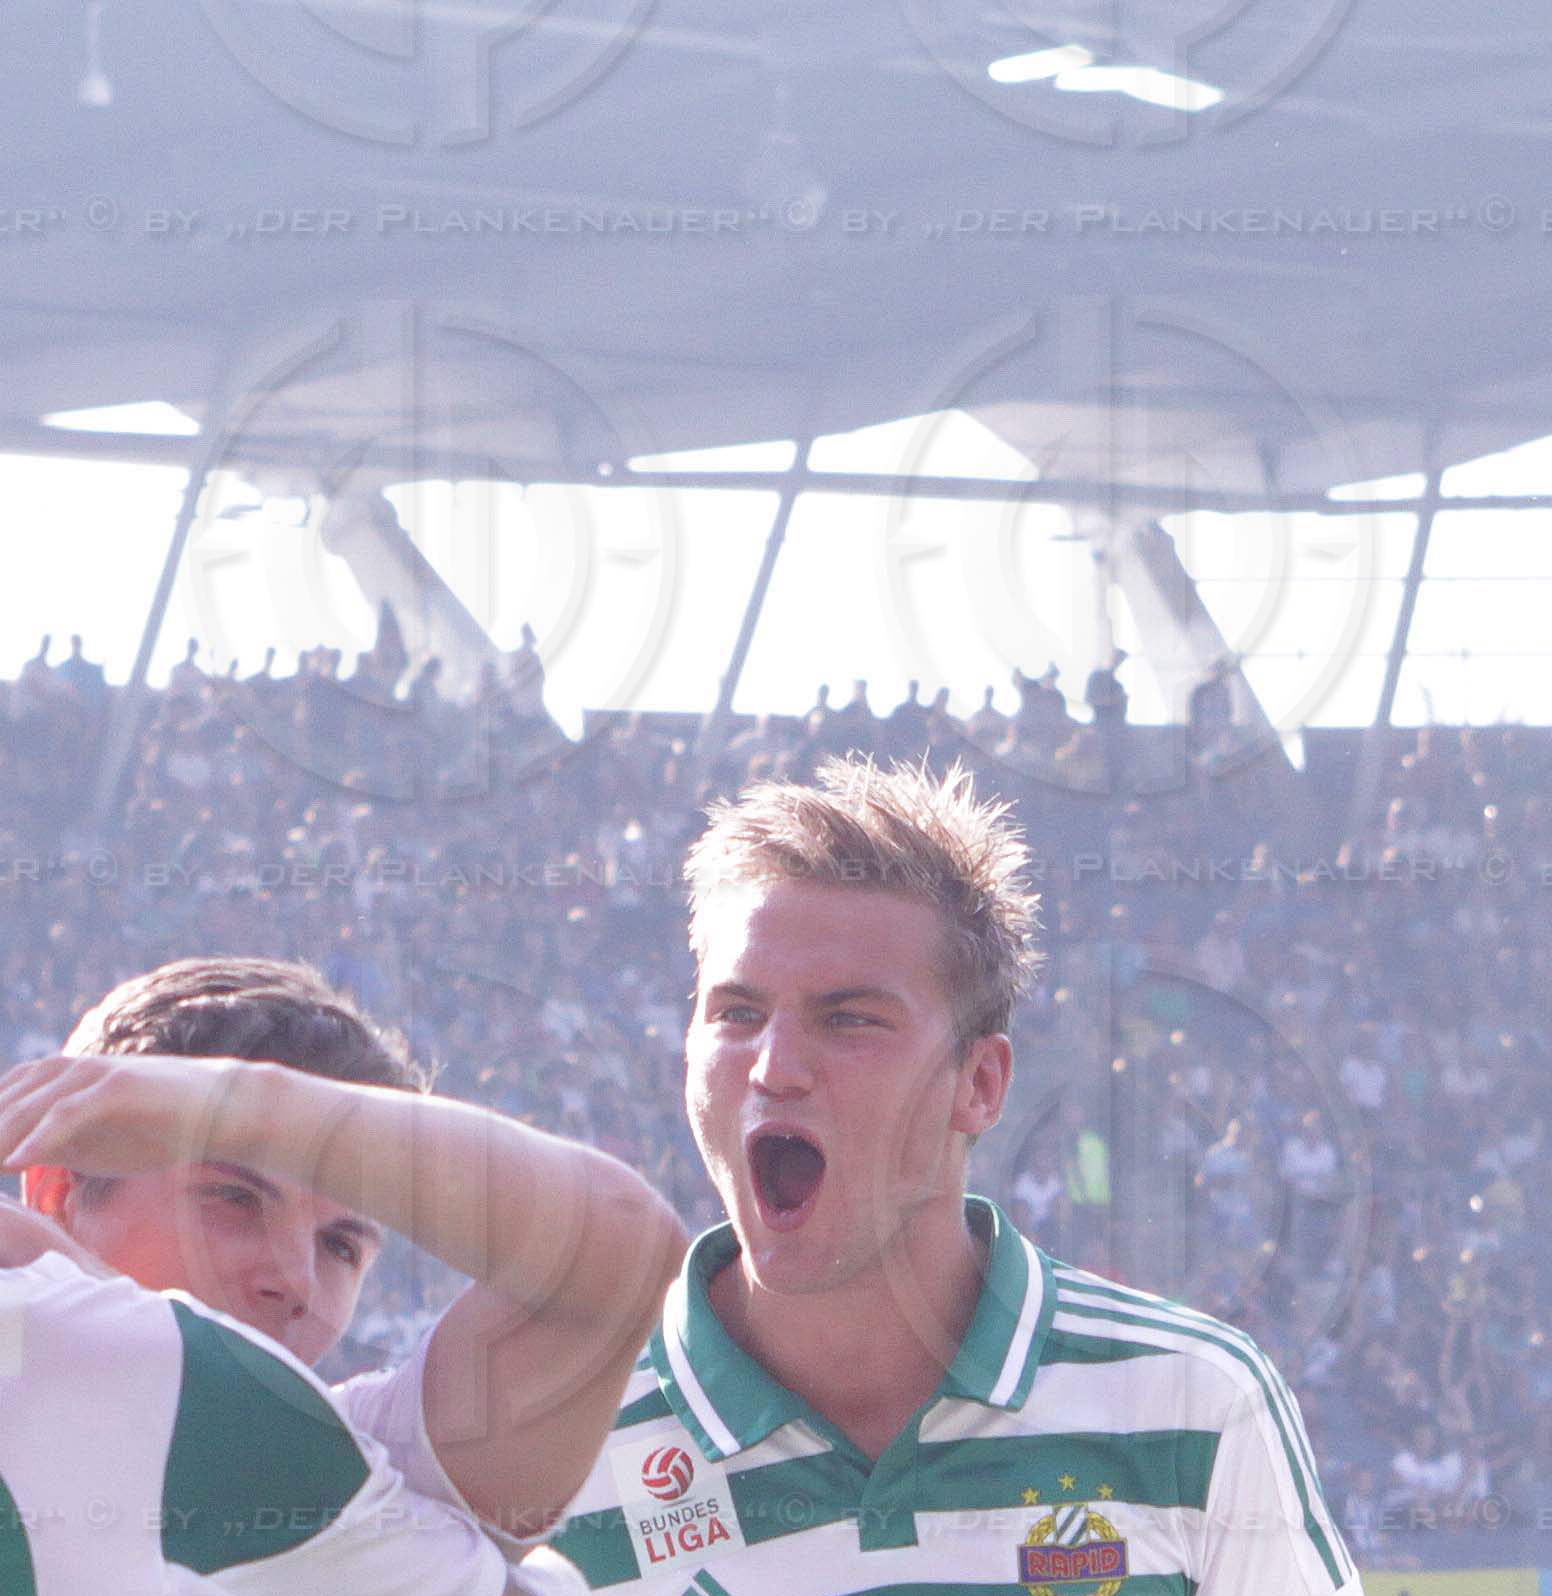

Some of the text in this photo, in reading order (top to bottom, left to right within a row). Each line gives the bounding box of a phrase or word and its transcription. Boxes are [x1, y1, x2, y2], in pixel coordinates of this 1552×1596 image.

[639, 1498, 720, 1537] BUNDES
[643, 1516, 732, 1565] LIGA
[1026, 1548, 1120, 1580] RAPID
